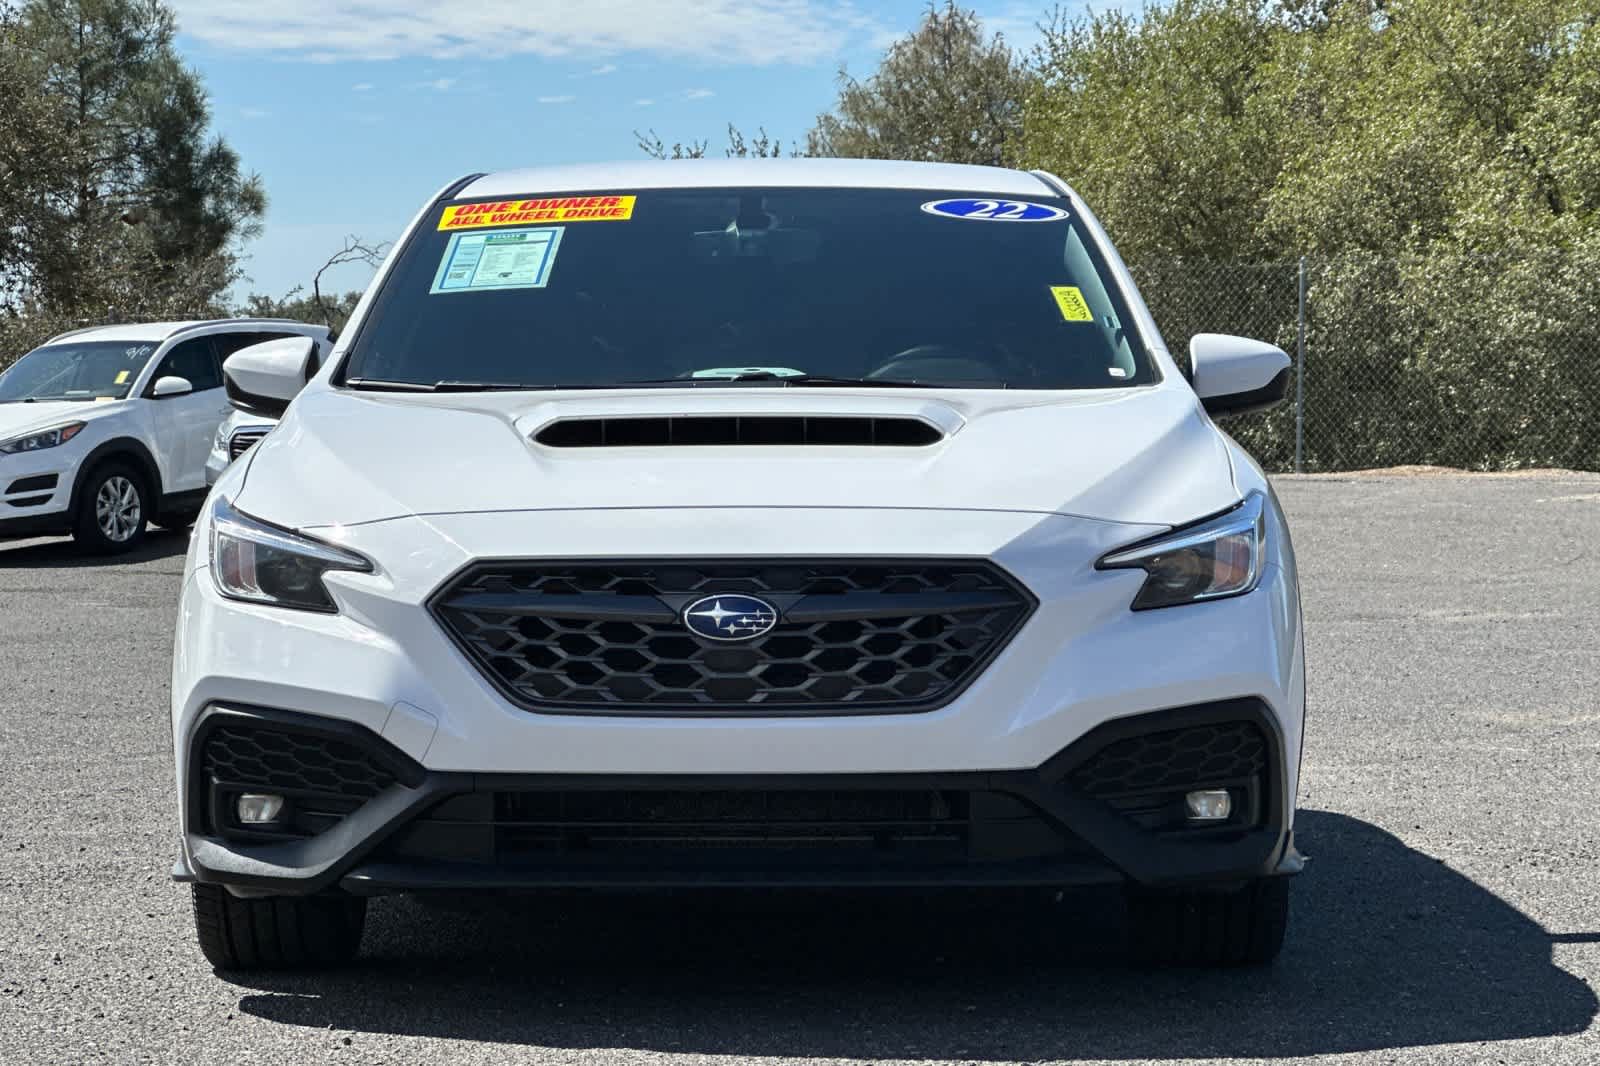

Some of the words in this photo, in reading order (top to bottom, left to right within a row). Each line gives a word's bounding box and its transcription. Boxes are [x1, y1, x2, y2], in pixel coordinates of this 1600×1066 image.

[454, 200, 514, 216] ONE
[518, 196, 623, 211] OWNER
[965, 201, 1029, 219] 22
[446, 215, 486, 226] ALL
[490, 210, 560, 222] WHEEL
[563, 207, 628, 218] DRIVE
